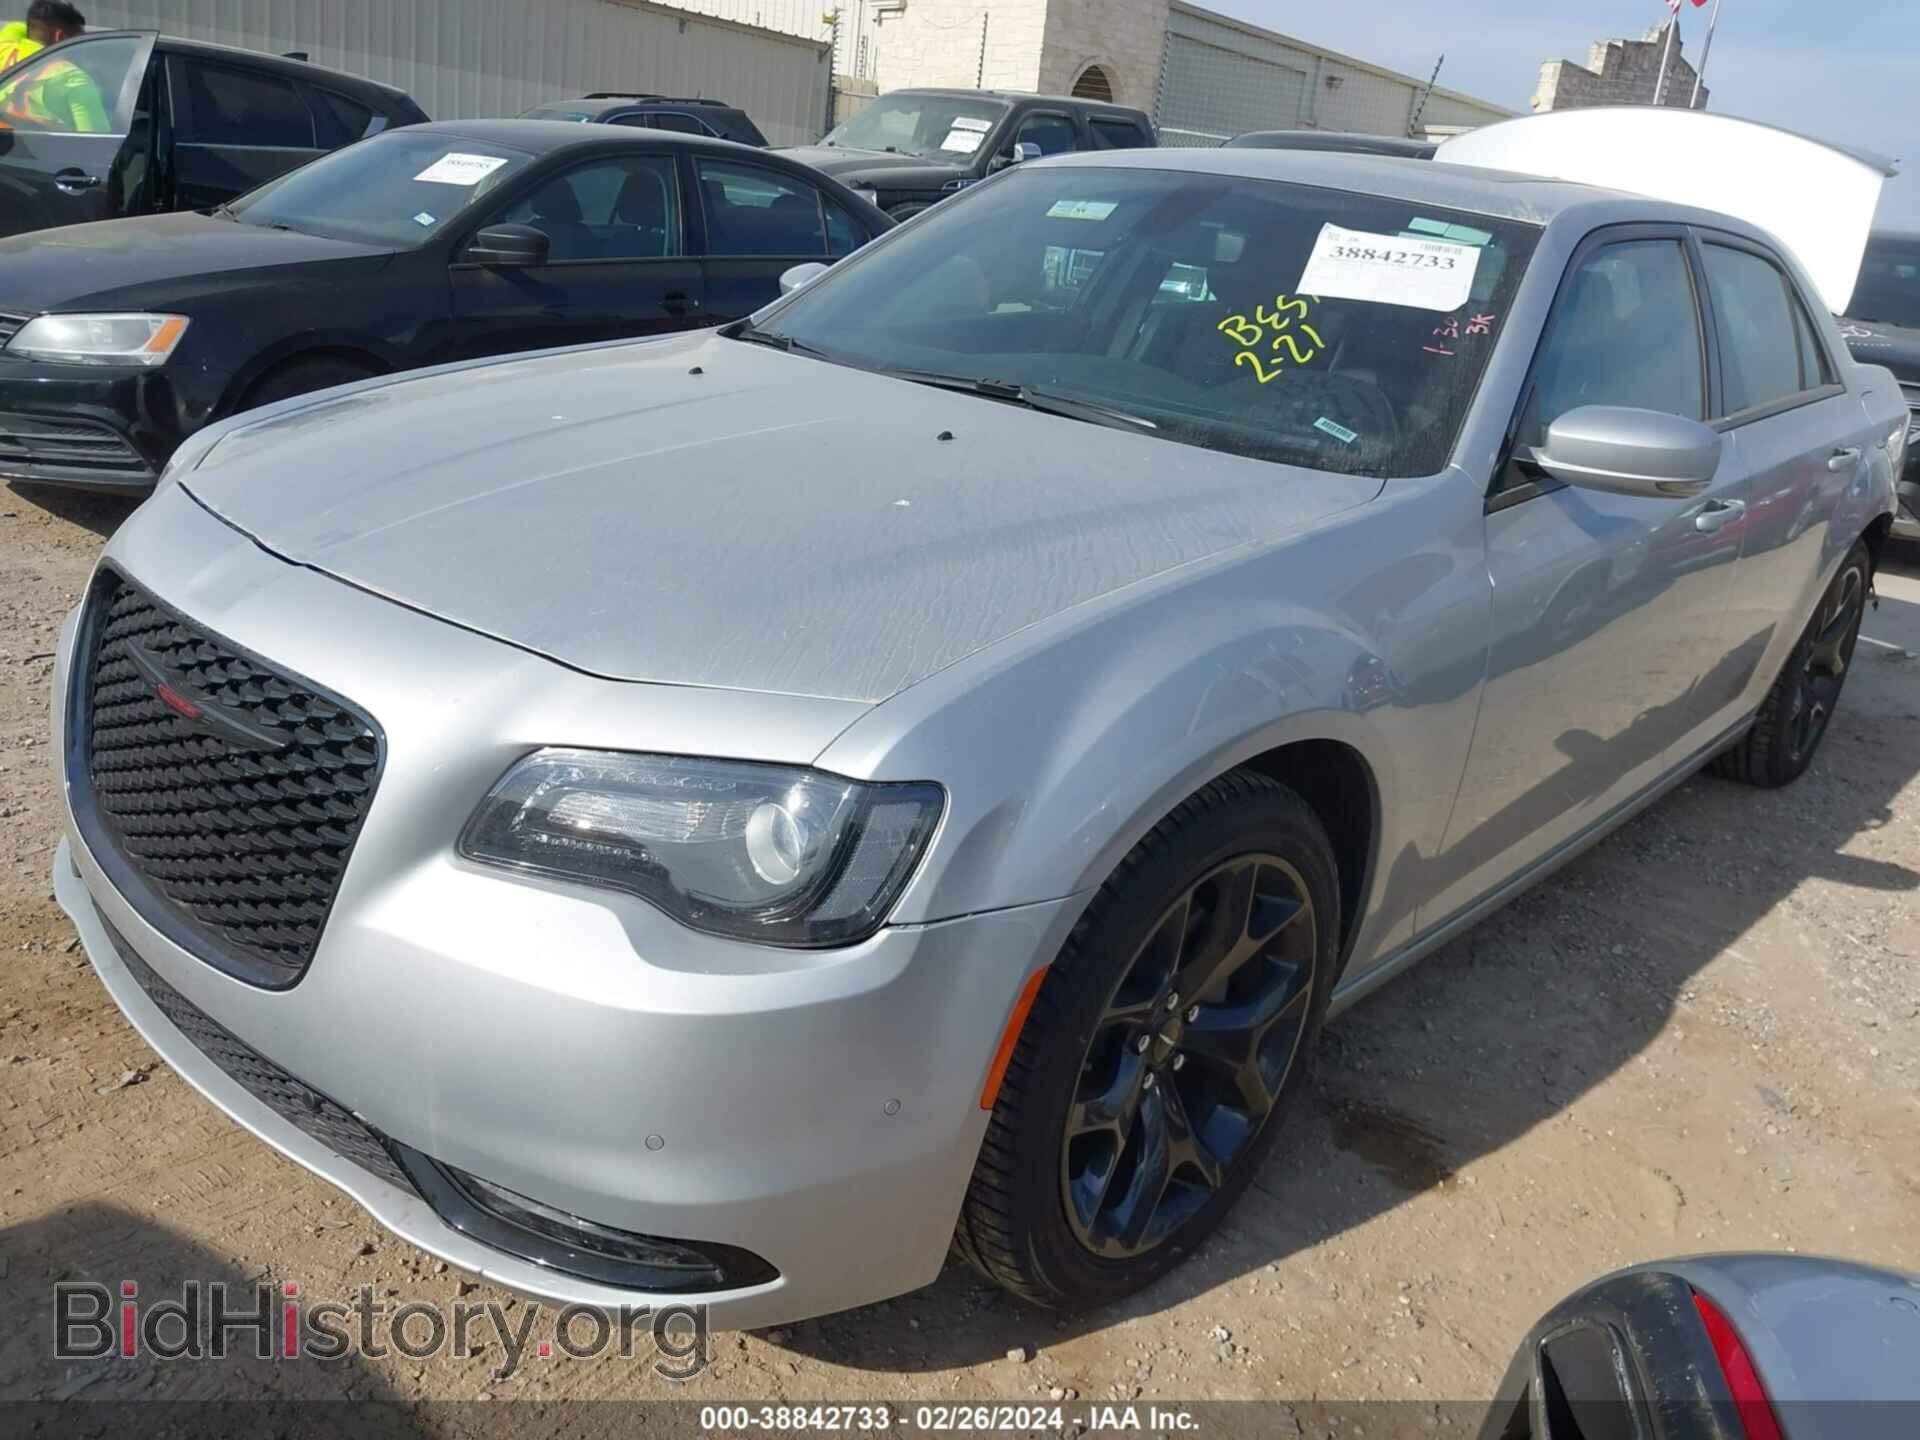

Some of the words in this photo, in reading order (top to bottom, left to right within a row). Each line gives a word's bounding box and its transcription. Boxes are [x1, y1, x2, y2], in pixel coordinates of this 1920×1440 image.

[1328, 245, 1456, 271] 38842733
[1218, 294, 1320, 346] BES
[1234, 324, 1325, 384] 2-21
